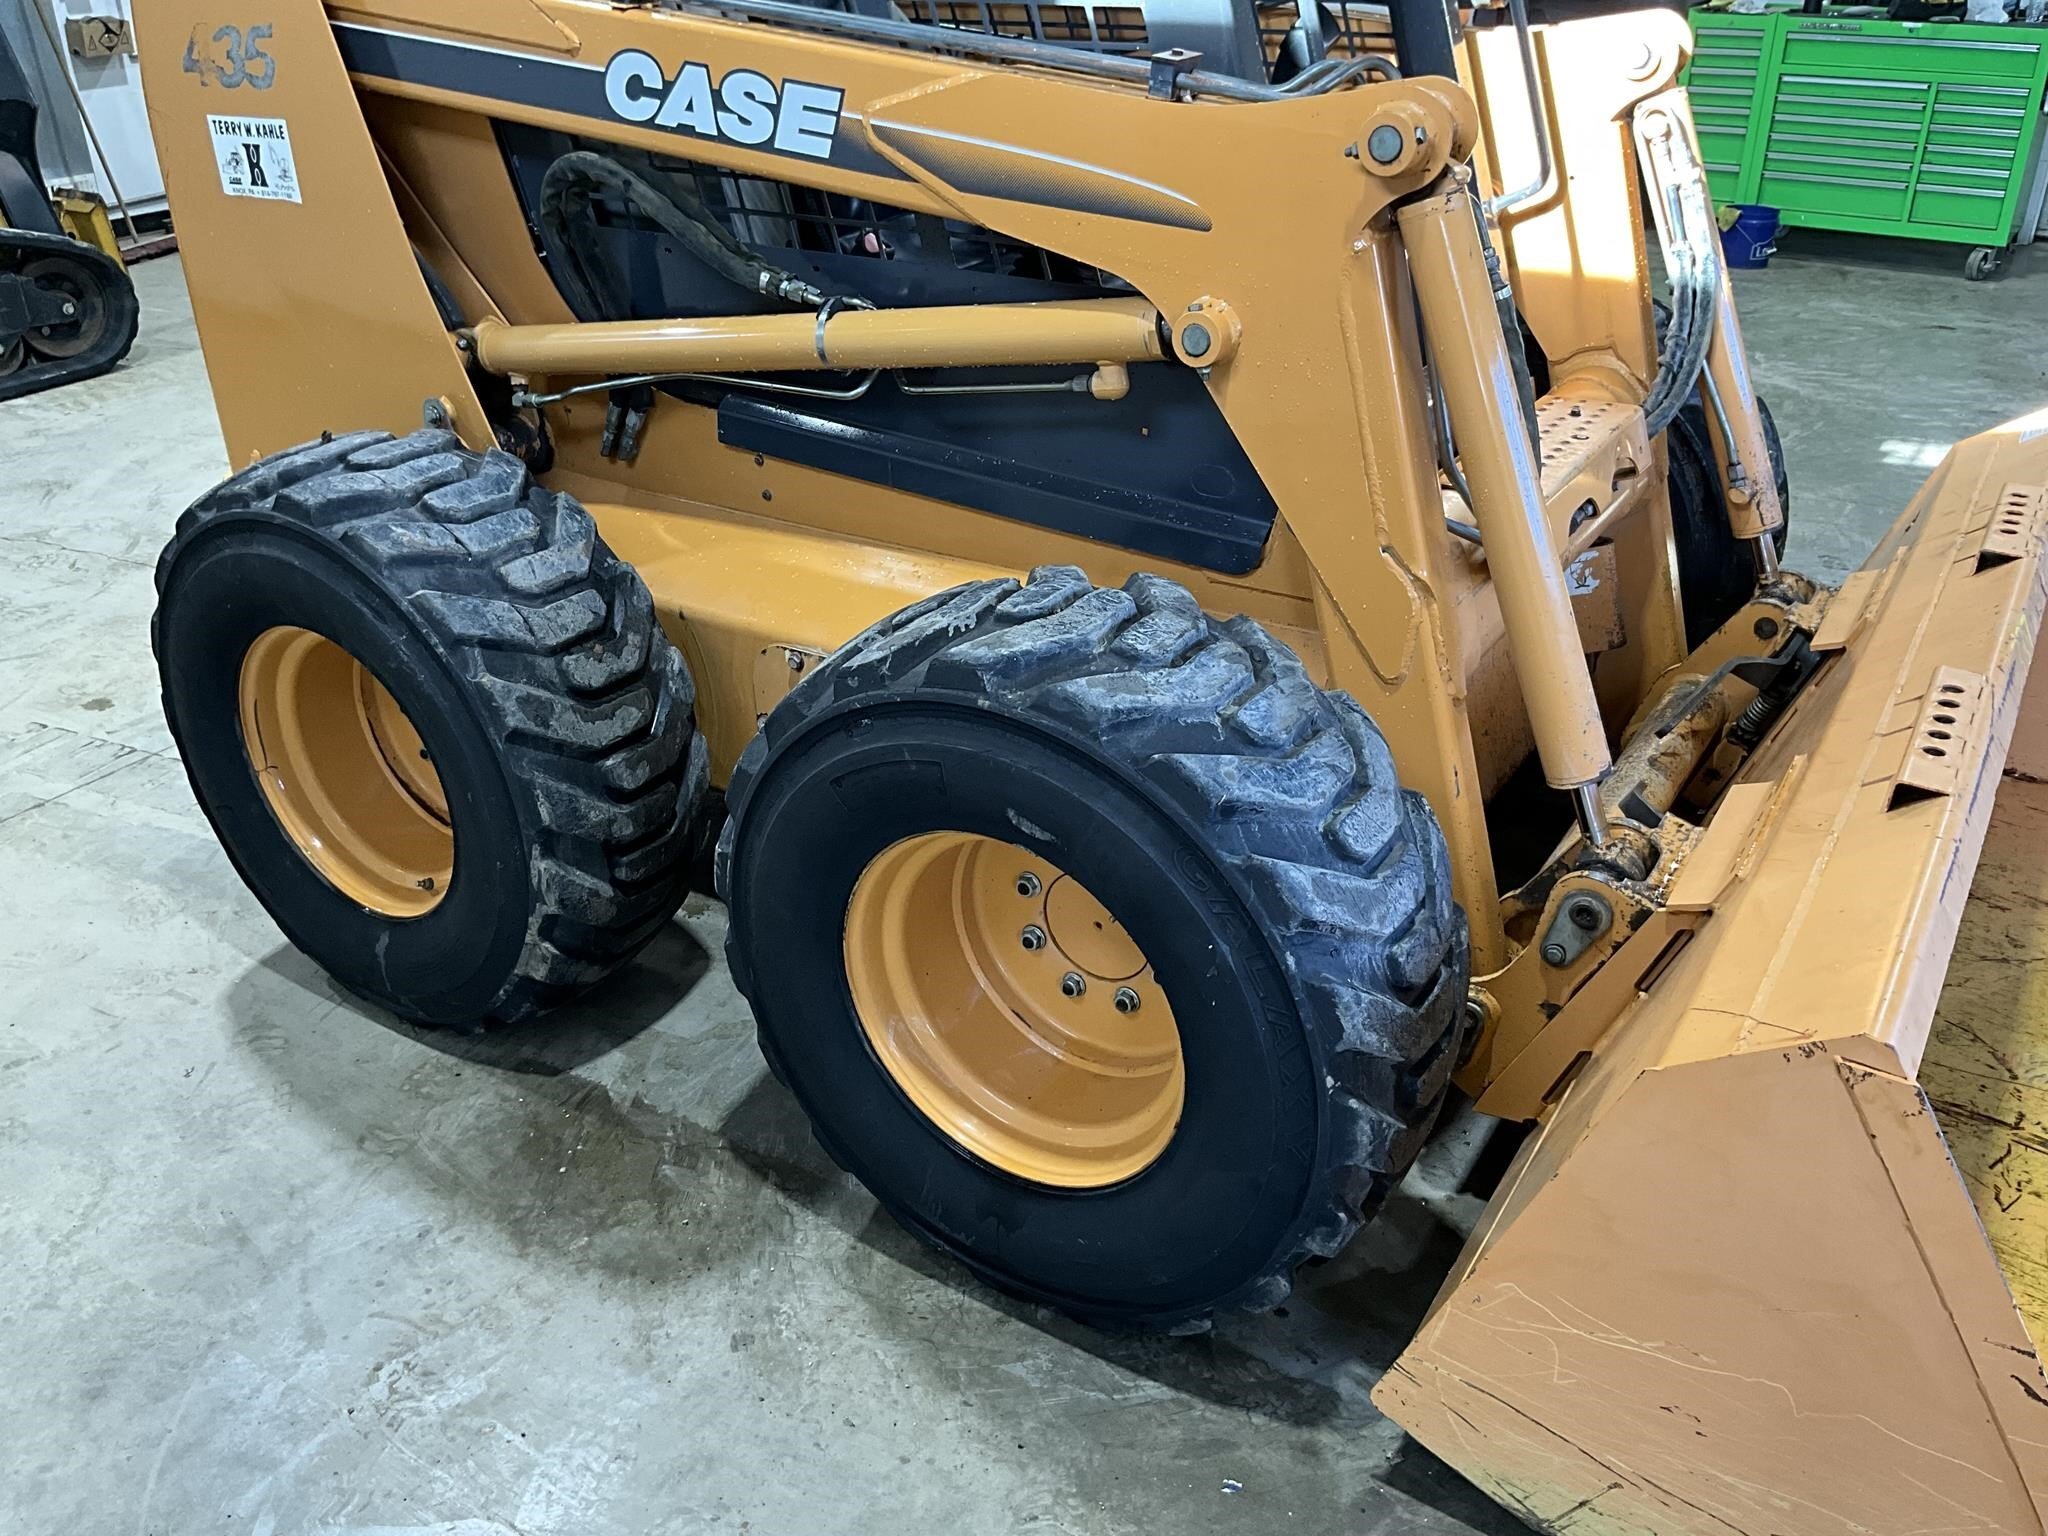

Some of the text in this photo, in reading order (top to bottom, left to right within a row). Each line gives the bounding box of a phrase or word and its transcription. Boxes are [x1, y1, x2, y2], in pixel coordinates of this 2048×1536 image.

[183, 22, 275, 88] 435
[212, 120, 285, 140] TERRY W. KAHLE
[605, 51, 843, 159] CASE
[242, 143, 269, 188] K
